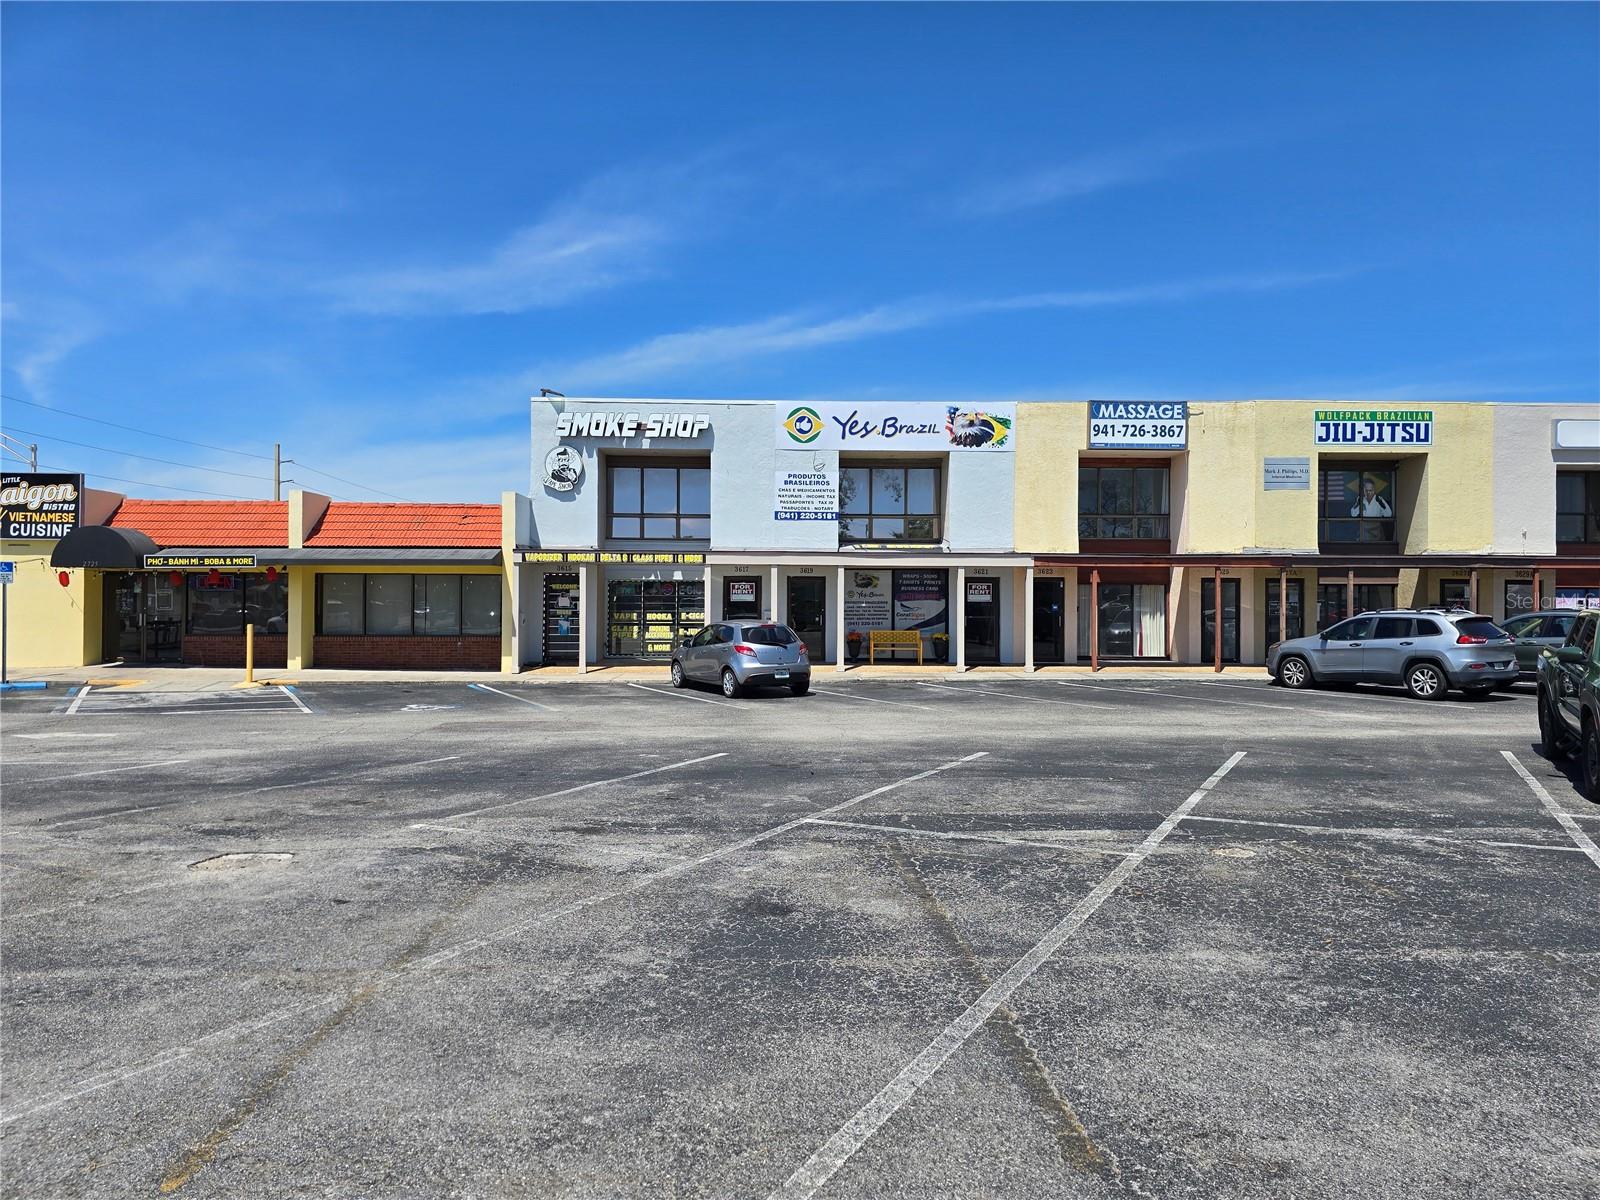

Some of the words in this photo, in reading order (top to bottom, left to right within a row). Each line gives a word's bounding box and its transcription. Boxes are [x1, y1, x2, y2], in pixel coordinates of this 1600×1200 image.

[1098, 404, 1183, 419] MASSAGE
[1318, 411, 1371, 420] WOLFPACK
[1376, 411, 1430, 420] BRAZILIAN
[556, 412, 640, 438] SMOKE
[645, 413, 710, 438] SHOP
[1092, 424, 1184, 438] 941-726-3867
[1317, 422, 1430, 443] JIU-JITSU
[2, 476, 21, 484] LITTLE
[0, 481, 78, 511] aigon
[42, 503, 76, 511] BISTRO
[8, 511, 76, 523] VIETNAMESE
[777, 512, 798, 520] (941)
[799, 512, 837, 520] 220-5181
[232, 557, 254, 565] MORE
